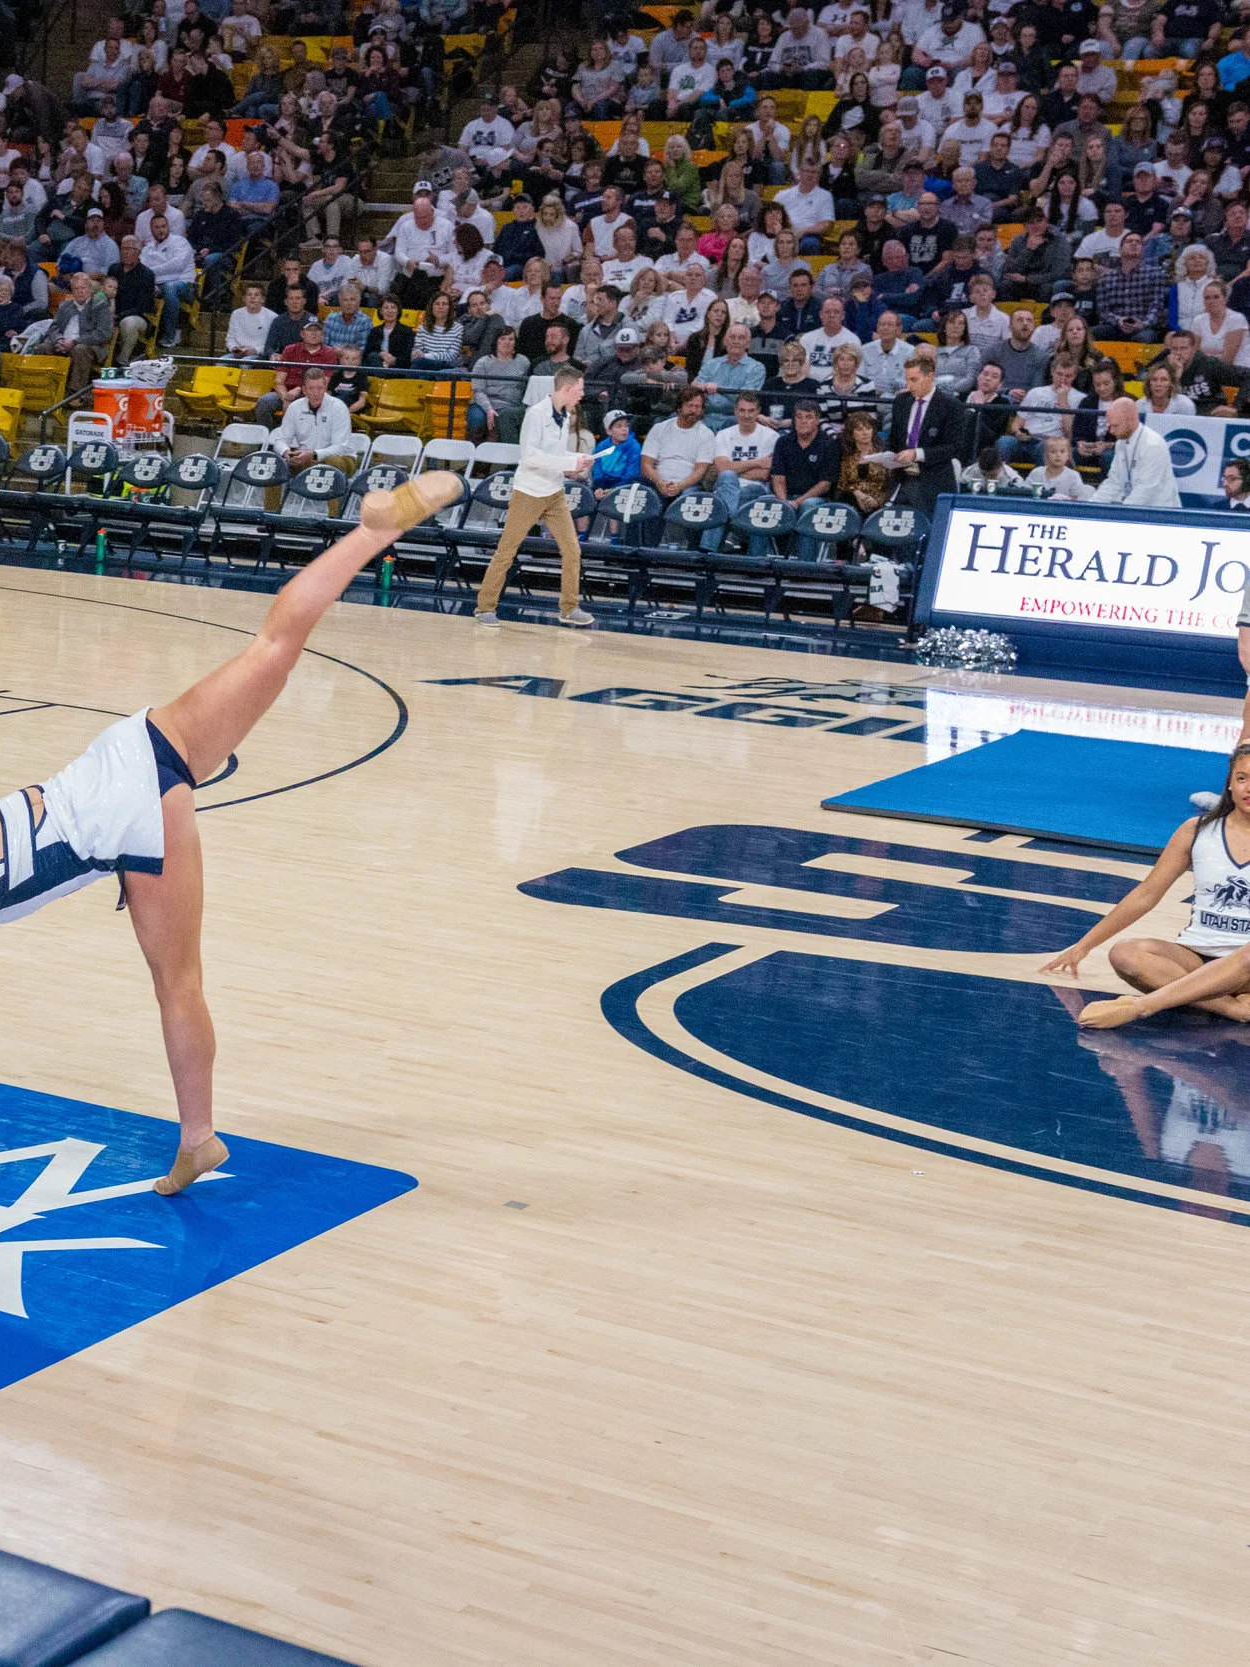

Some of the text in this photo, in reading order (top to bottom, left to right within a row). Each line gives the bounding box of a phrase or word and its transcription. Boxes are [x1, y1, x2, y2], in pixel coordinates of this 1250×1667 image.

[75, 428, 104, 438] GATORADE
[1230, 432, 1250, 457] C
[1027, 522, 1068, 541] THE
[960, 522, 1250, 601] HERALD JO
[1019, 596, 1159, 625] EMPOWERING
[1165, 609, 1205, 628] THE
[416, 674, 928, 745] AGGI
[1200, 909, 1250, 933] UTAH STA
